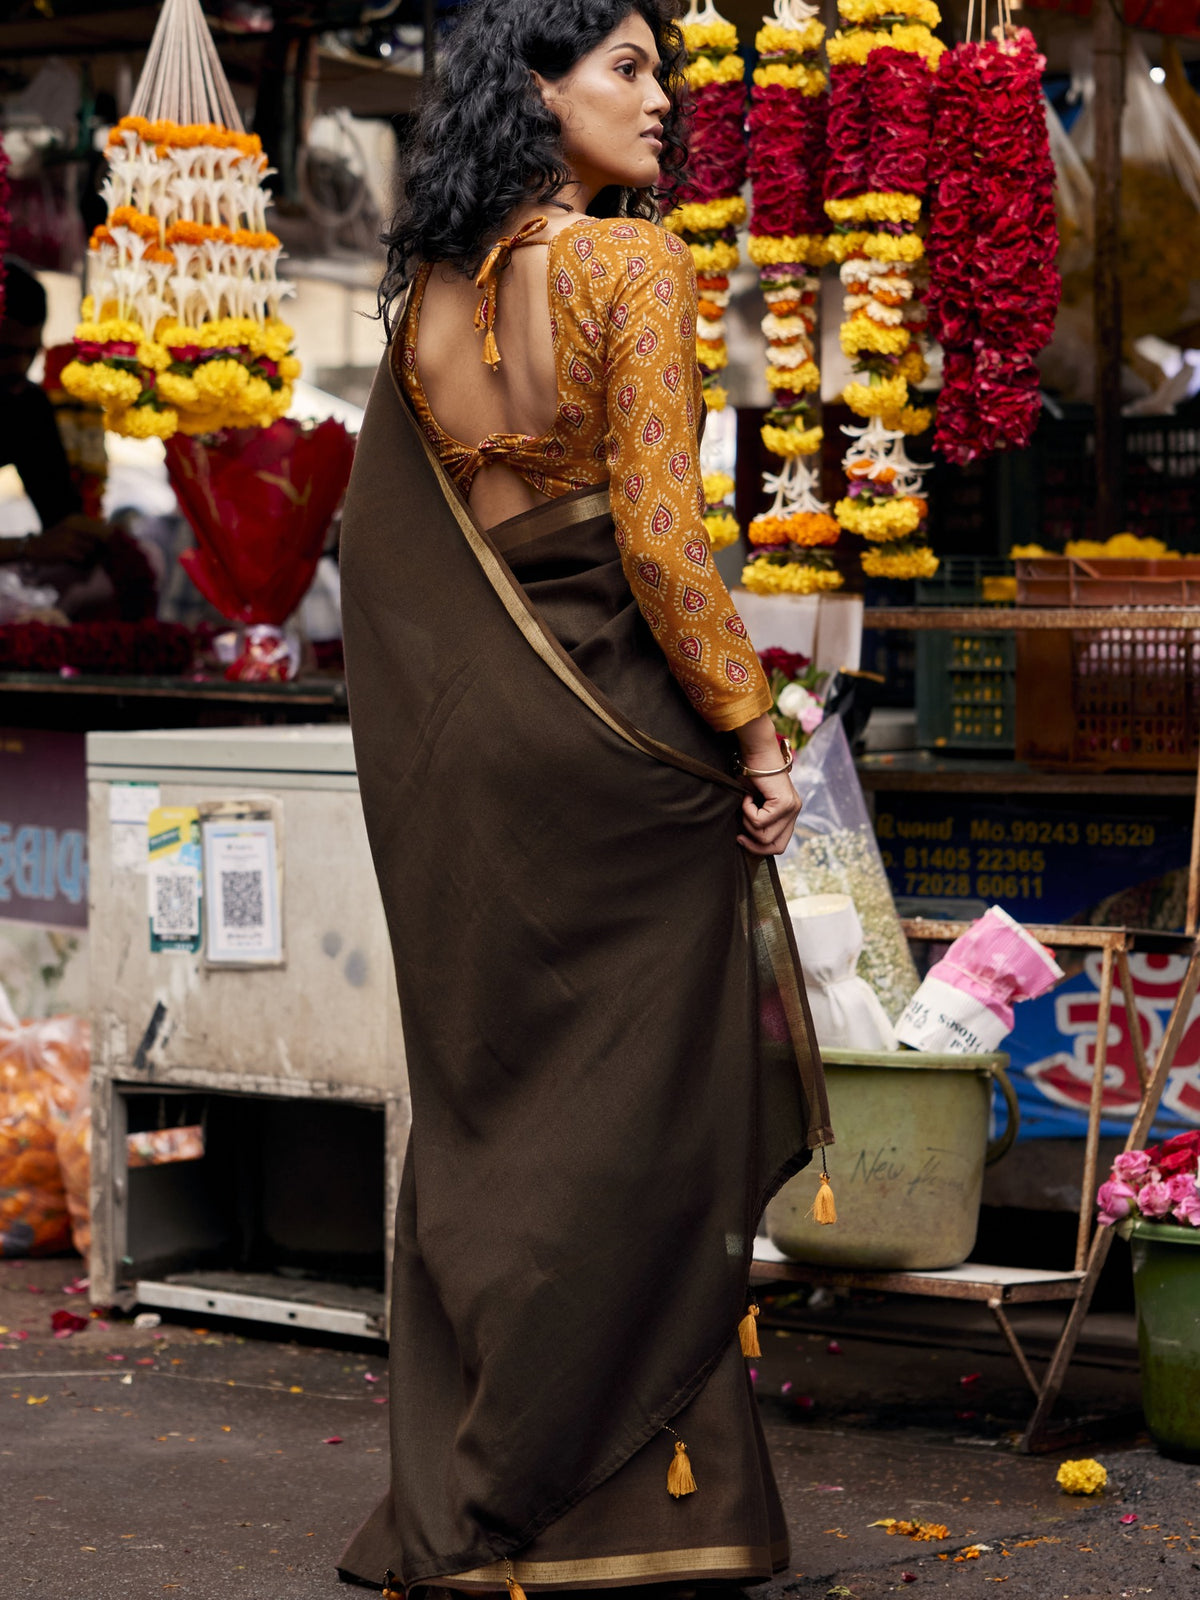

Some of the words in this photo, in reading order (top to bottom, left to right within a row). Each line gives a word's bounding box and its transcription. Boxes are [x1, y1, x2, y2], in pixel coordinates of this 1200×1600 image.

[1086, 822, 1155, 847] 95529
[904, 847, 970, 870] 81405
[976, 848, 1046, 872] 22365
[976, 875, 1044, 898] 60611
